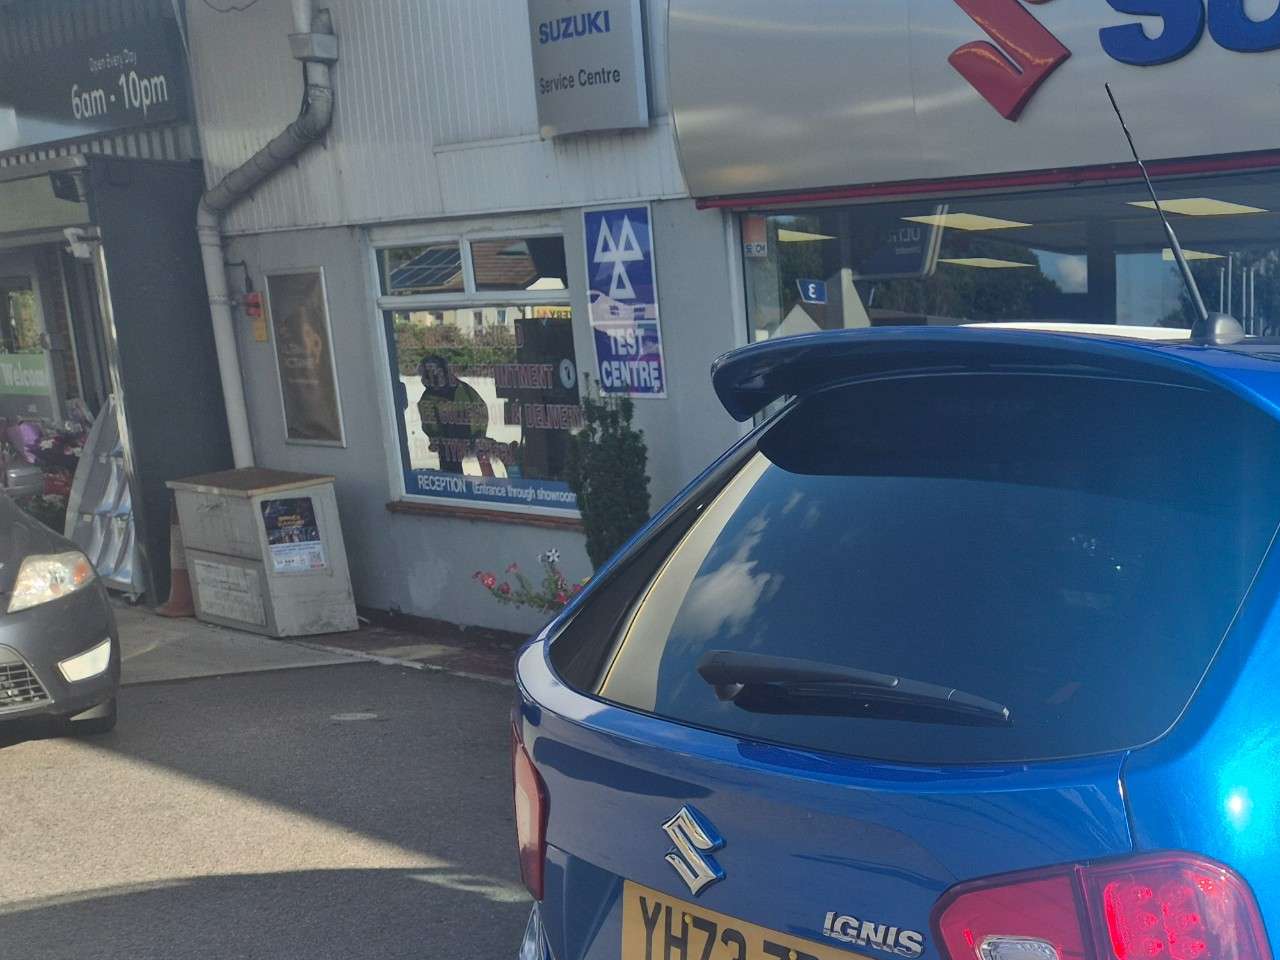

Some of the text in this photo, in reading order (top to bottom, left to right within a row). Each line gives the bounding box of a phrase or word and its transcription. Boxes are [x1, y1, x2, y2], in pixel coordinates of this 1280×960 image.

[539, 10, 610, 44] SUZUKI
[72, 83, 107, 119] 6am
[119, 70, 168, 116] 10pm
[539, 67, 621, 95] Service Centre
[607, 328, 645, 355] TEST
[602, 361, 660, 387] CENTRE
[417, 475, 466, 494] RECEPTION
[507, 485, 536, 501] through
[823, 911, 924, 959] IGNIS
